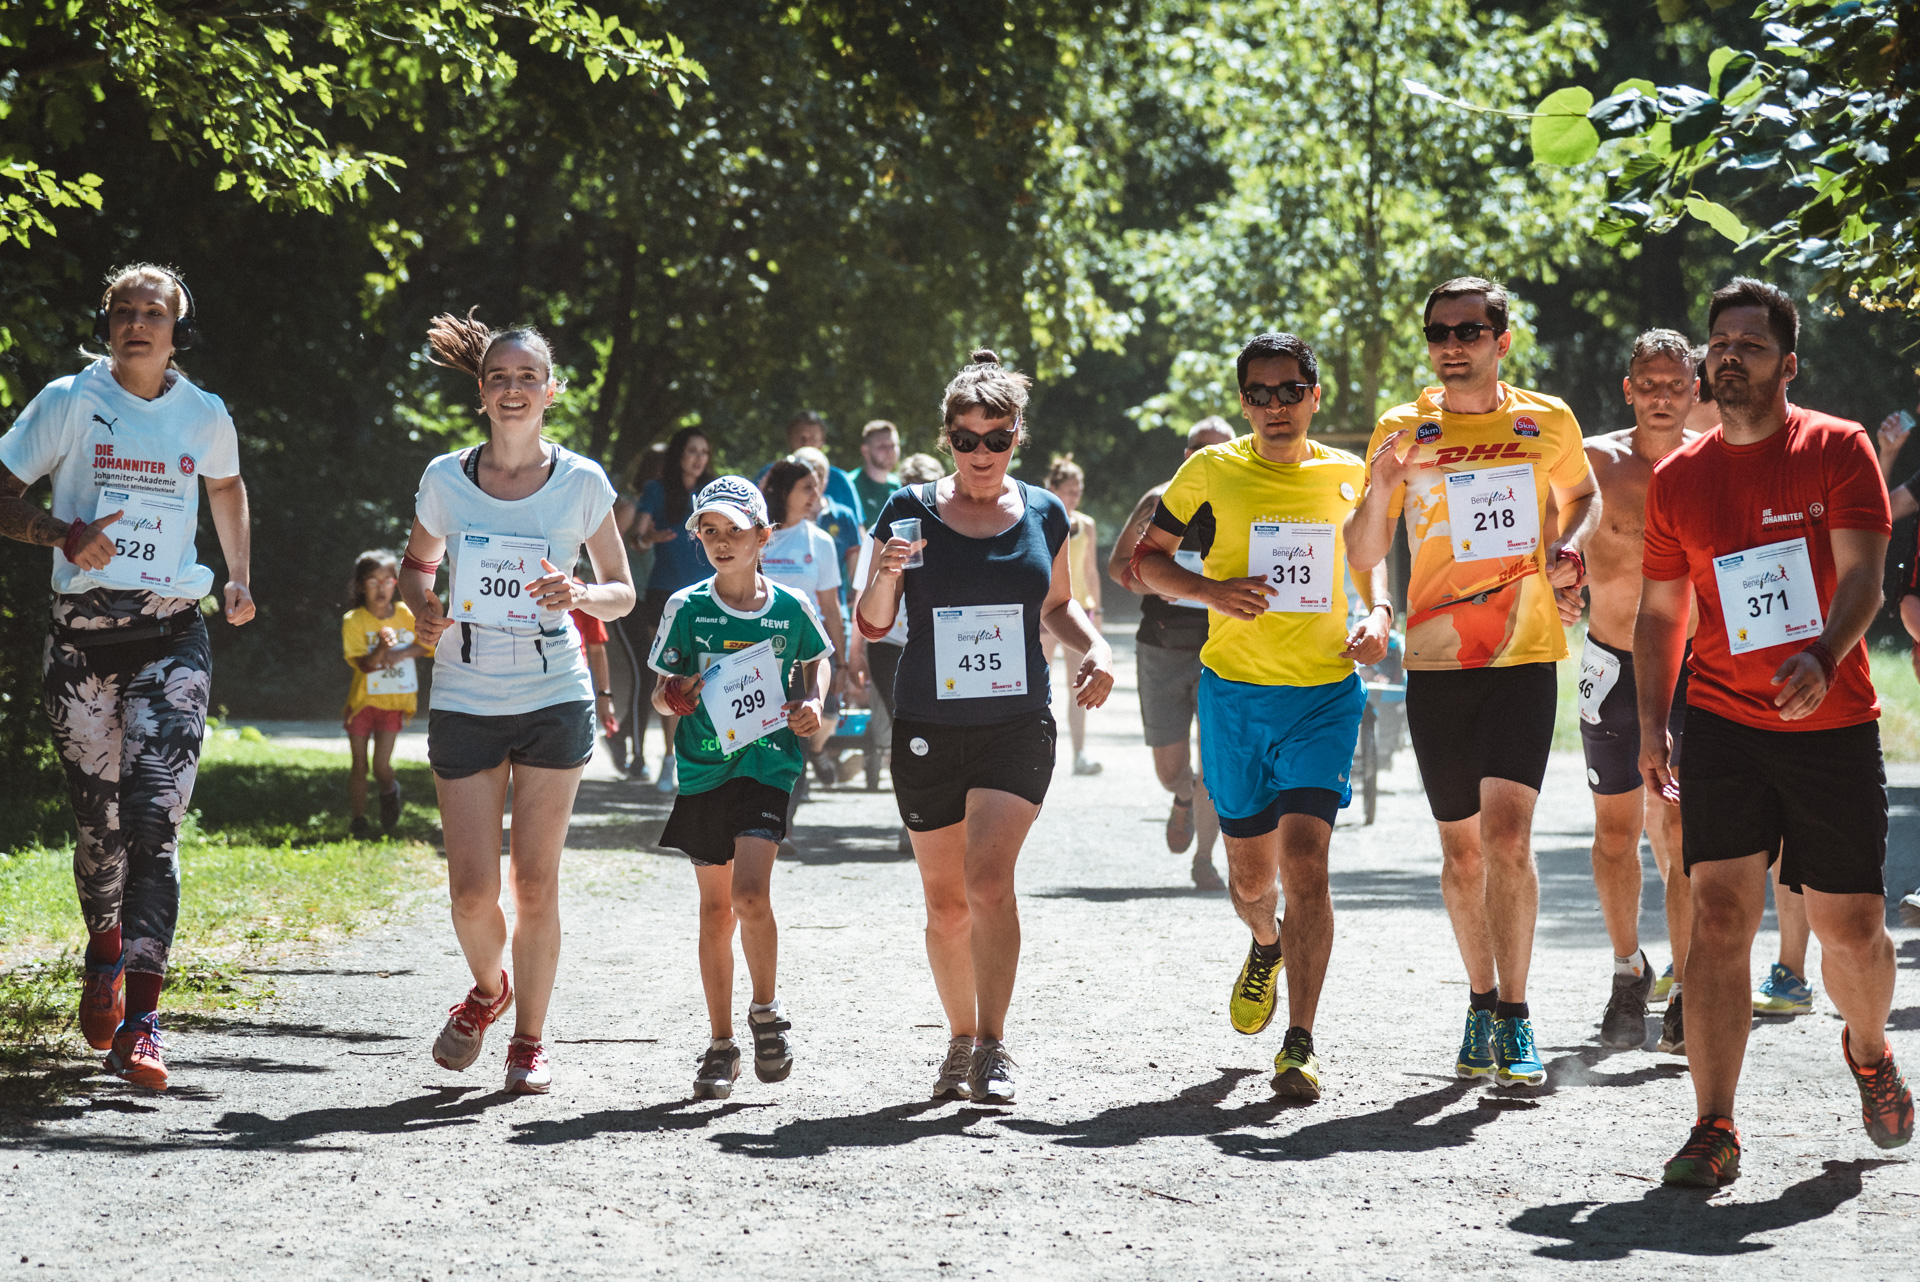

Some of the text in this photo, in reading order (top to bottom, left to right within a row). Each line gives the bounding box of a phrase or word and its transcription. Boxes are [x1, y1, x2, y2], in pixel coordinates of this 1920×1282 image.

[1420, 428, 1438, 436] 5km
[95, 444, 114, 456] DIE
[1435, 442, 1528, 466] DHL
[92, 457, 166, 474] JOHANNITER
[94, 471, 176, 486] Johanniter-Akademie
[130, 484, 175, 494] Mitteldeutschland
[1474, 508, 1515, 531] 218
[1762, 508, 1772, 517] DIE
[1762, 512, 1804, 525] JOHANNITER
[115, 538, 156, 561] 528
[1272, 565, 1311, 584] 313
[480, 577, 520, 598] 300
[1747, 590, 1789, 618] 371
[760, 618, 790, 629] REWE
[546, 638, 569, 648] humme
[958, 653, 1001, 672] 435
[732, 689, 765, 719] 299
